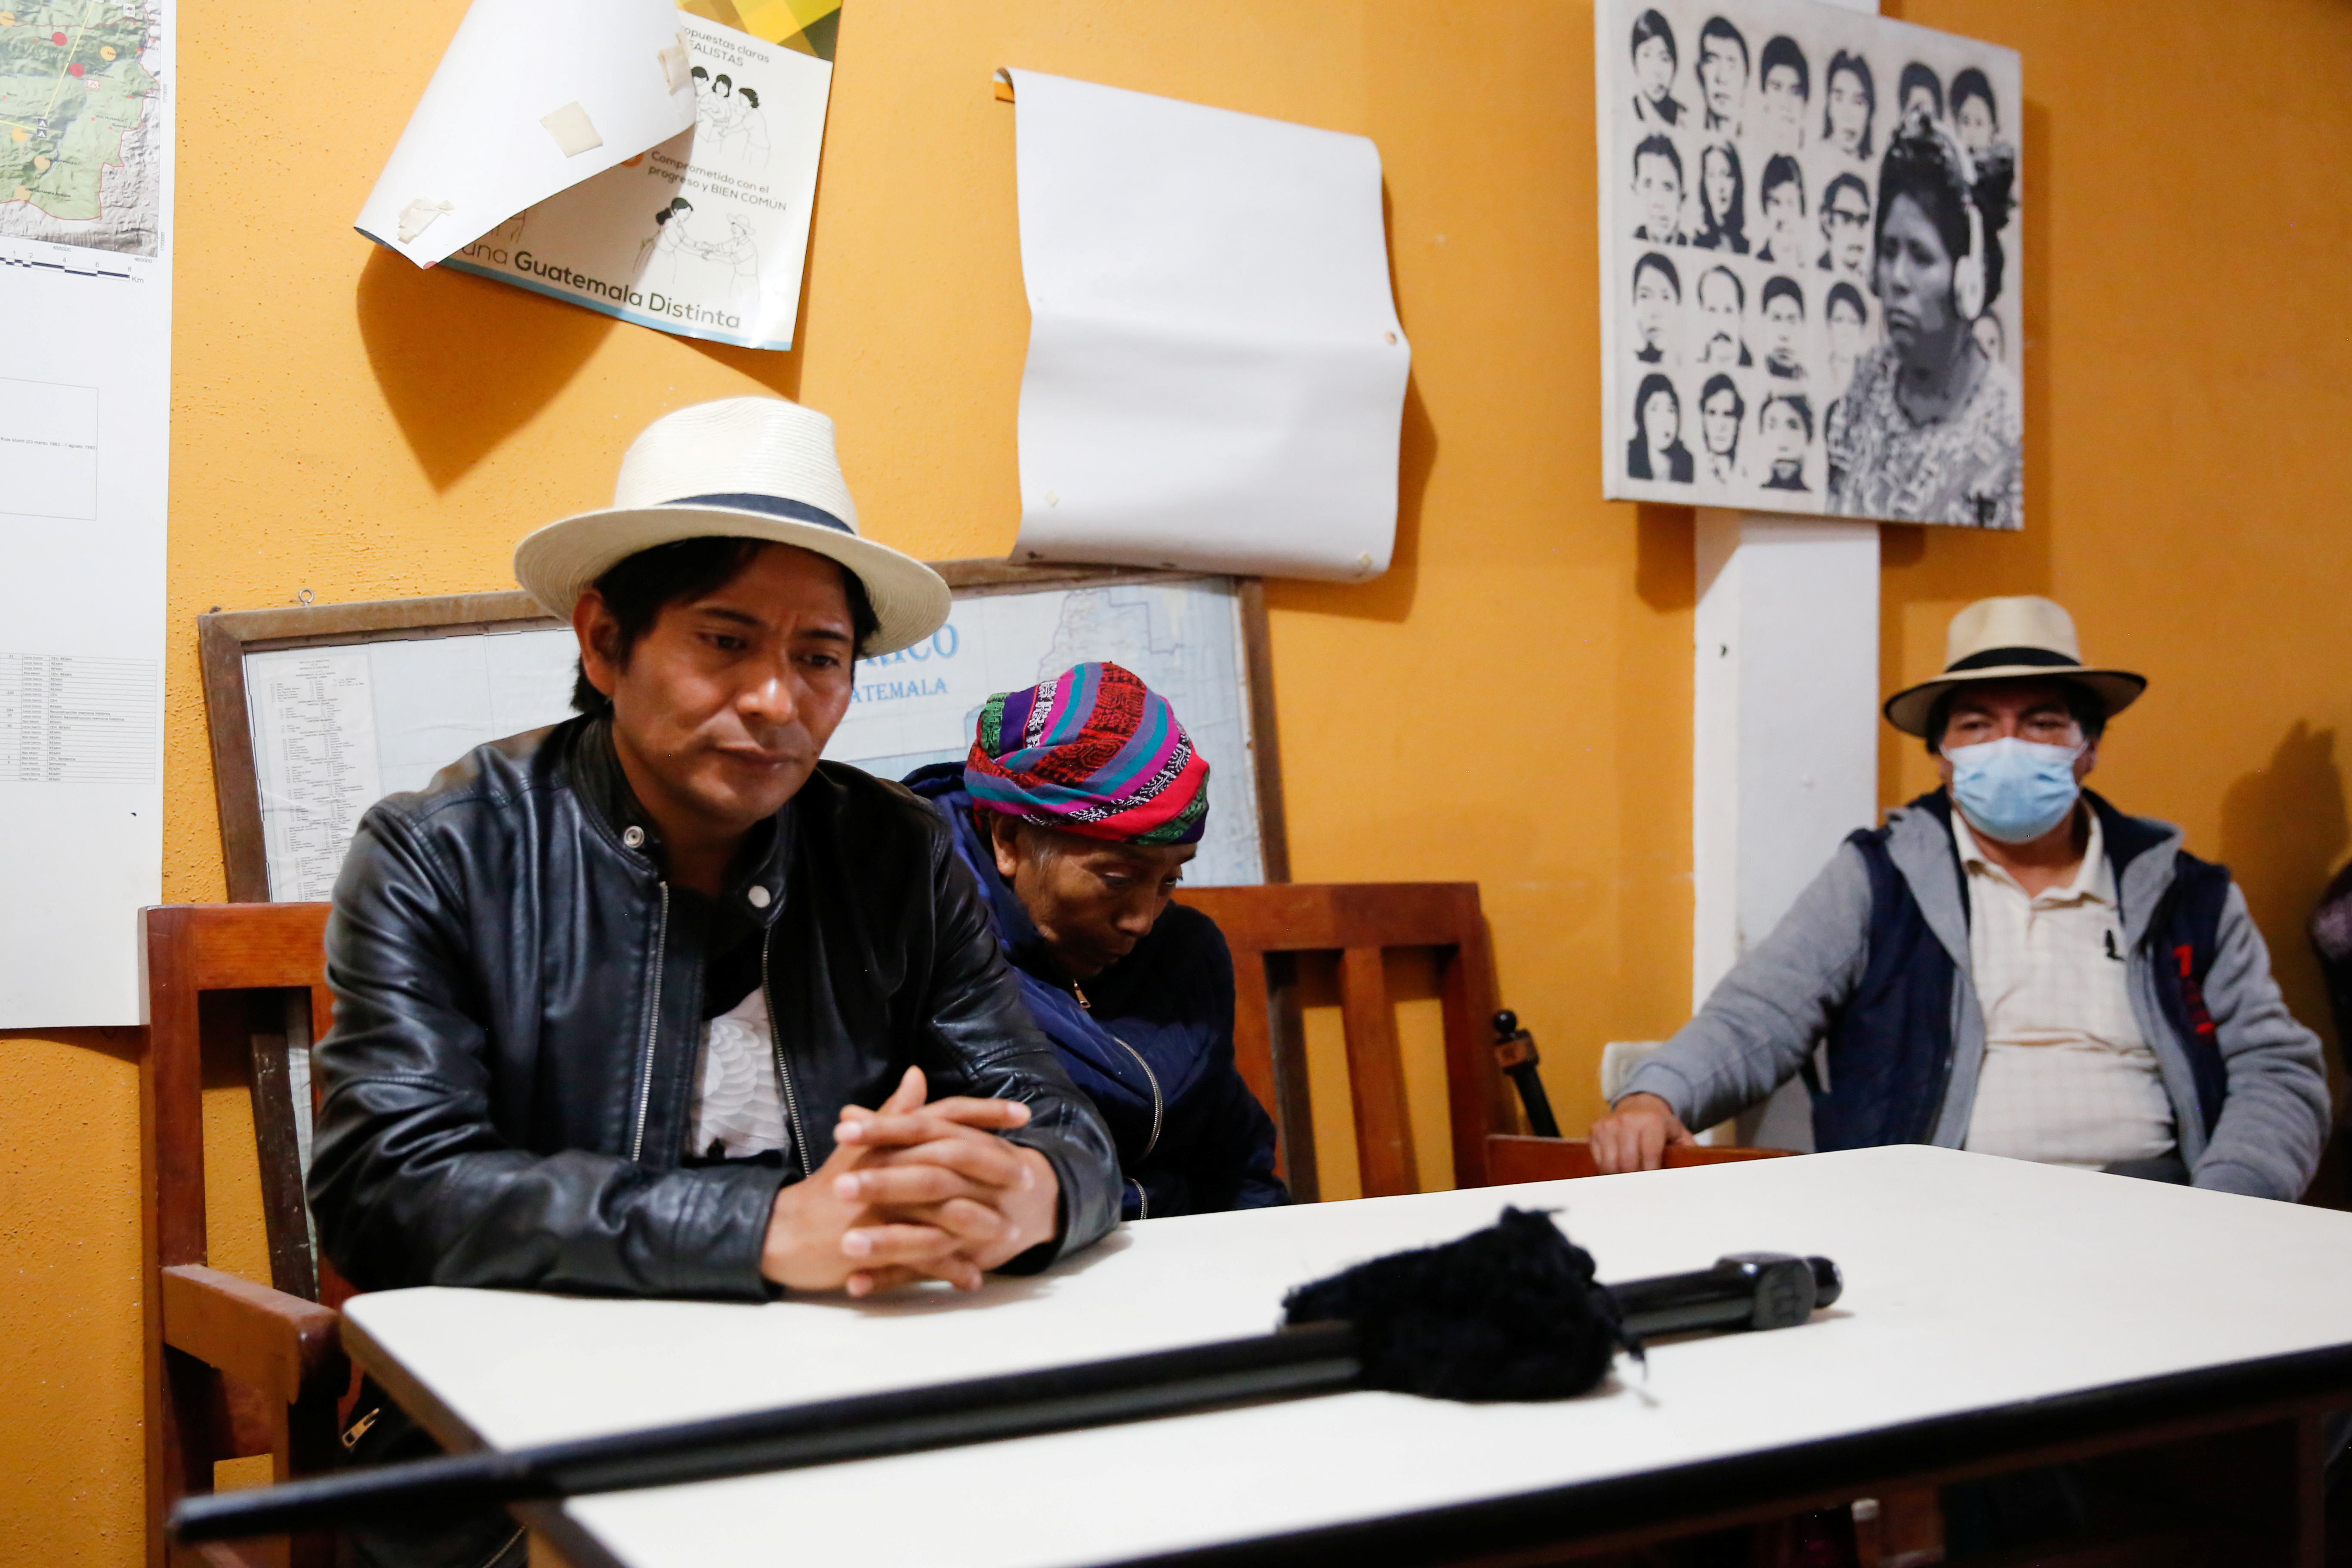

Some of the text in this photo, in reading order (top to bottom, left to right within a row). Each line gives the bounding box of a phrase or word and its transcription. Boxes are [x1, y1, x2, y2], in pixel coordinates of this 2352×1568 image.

[682, 25, 769, 63] opuestas claras
[689, 39, 744, 66] ALISTAS
[648, 166, 787, 211] progreso y BIEN COMÚN
[651, 150, 769, 194] Comprometido con el
[462, 243, 740, 329] una Guatemala Distinta
[850, 677, 948, 703] ATEMALA
